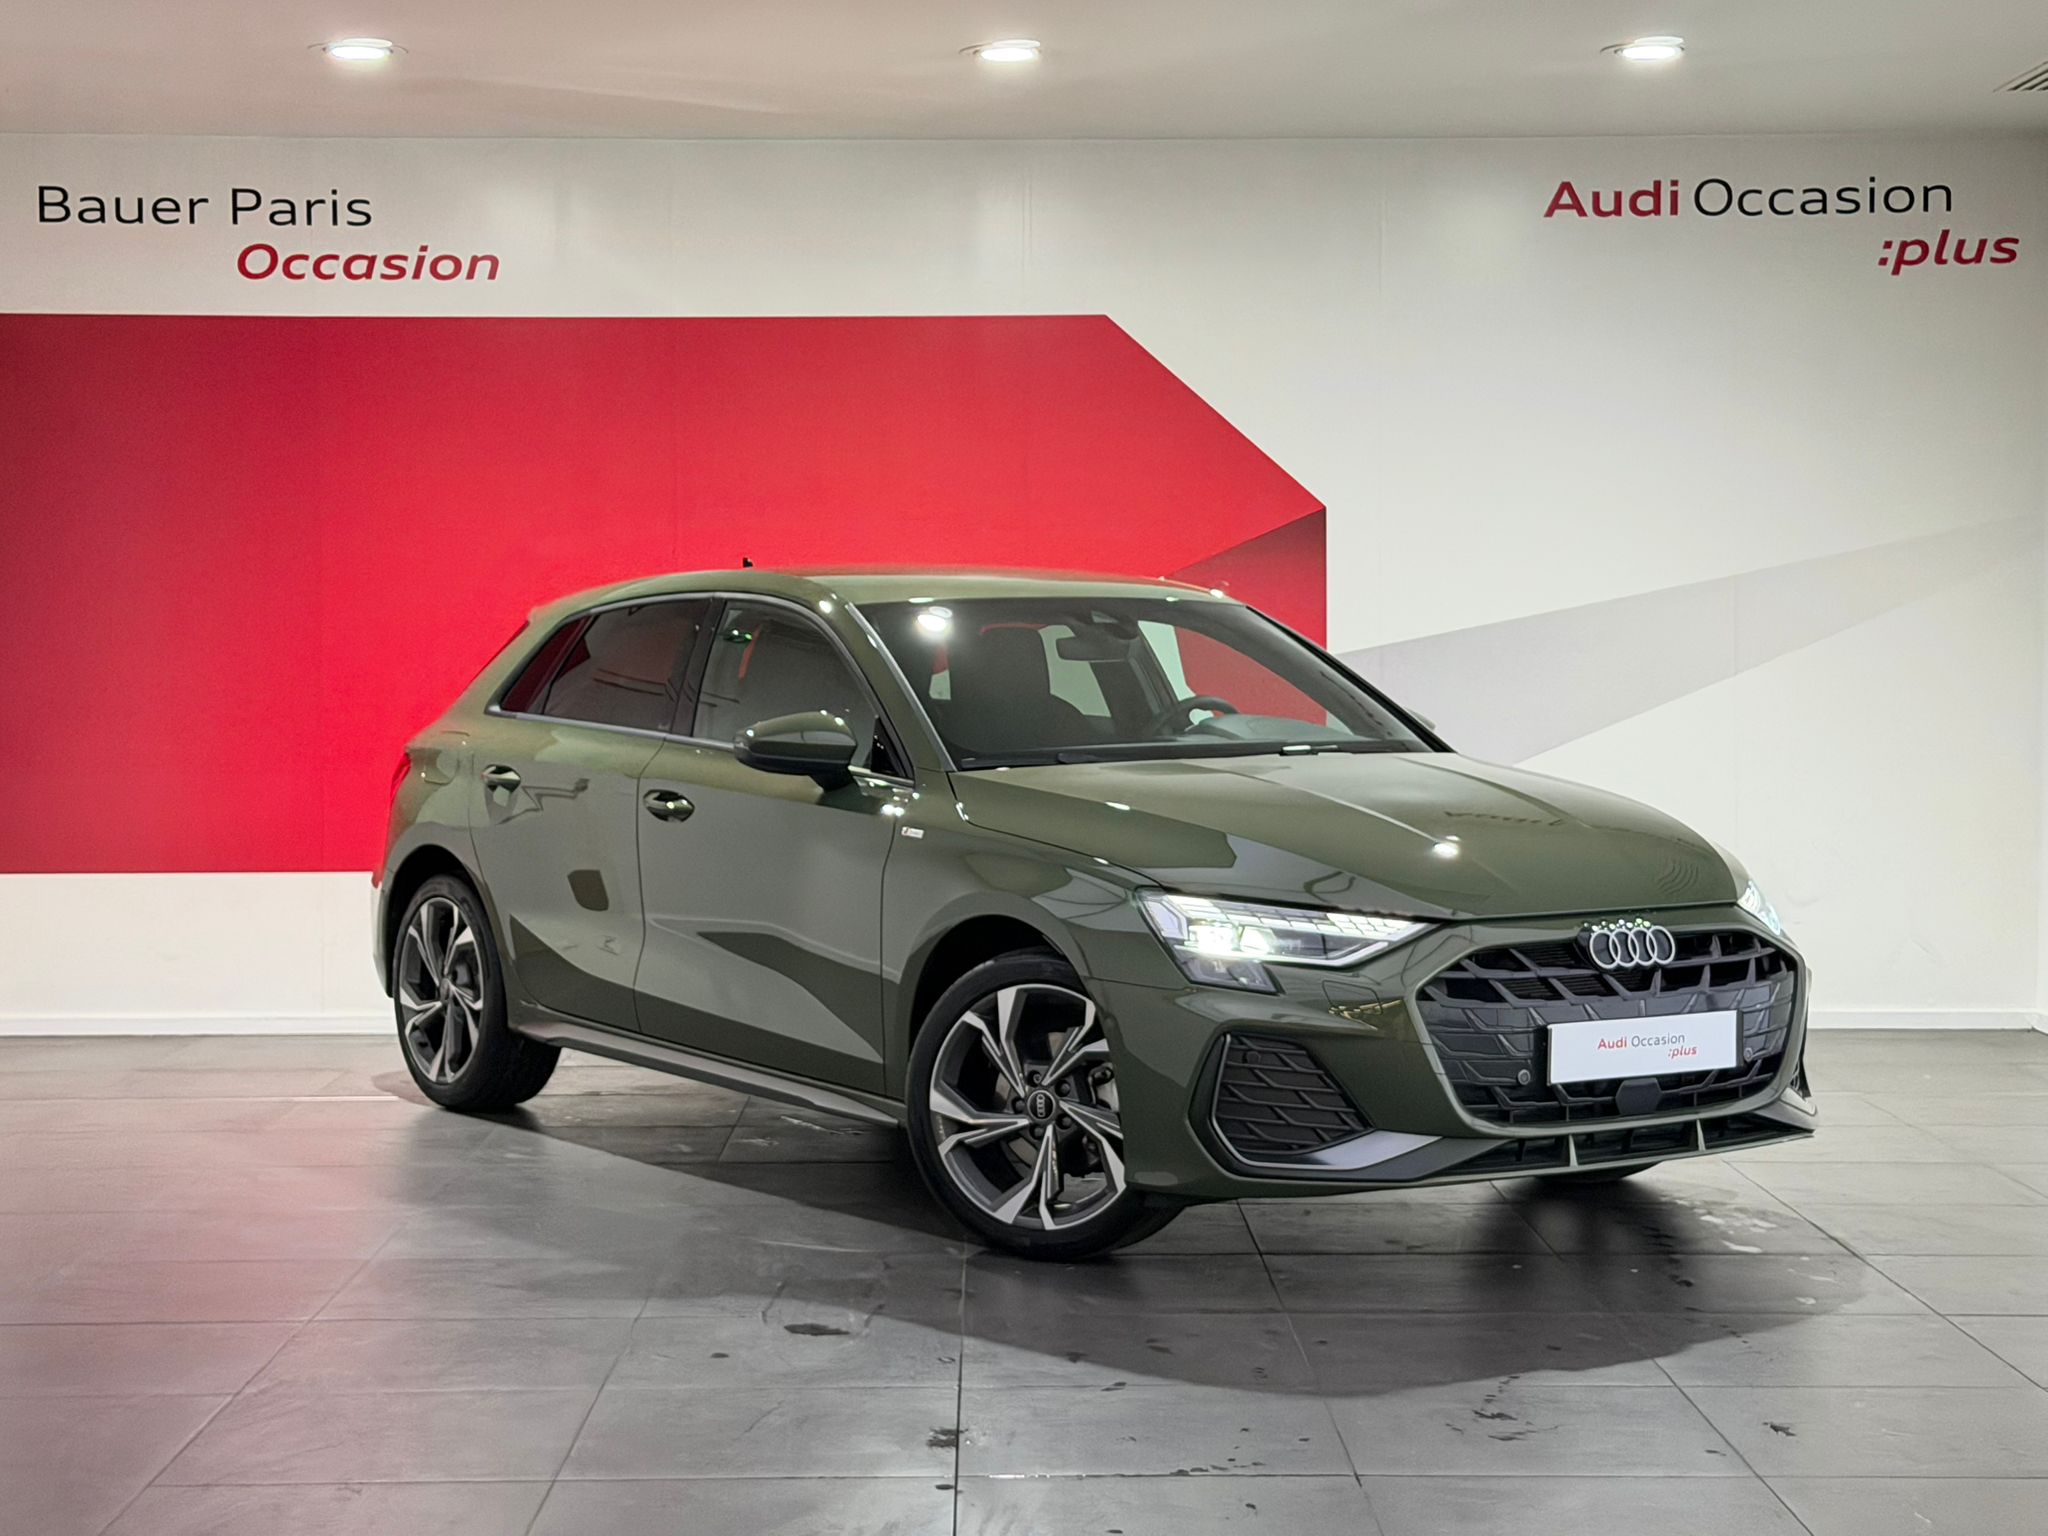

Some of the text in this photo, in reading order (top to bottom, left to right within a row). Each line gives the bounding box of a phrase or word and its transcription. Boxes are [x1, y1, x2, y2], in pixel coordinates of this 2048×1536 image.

[37, 185, 373, 226] Bauer Paris
[1543, 176, 1953, 218] Audi Occasion
[236, 243, 500, 281] Occasion
[1877, 228, 2020, 276] :plus
[1598, 1033, 1685, 1049] Audi Occasion
[1669, 1046, 1697, 1059] :plus
